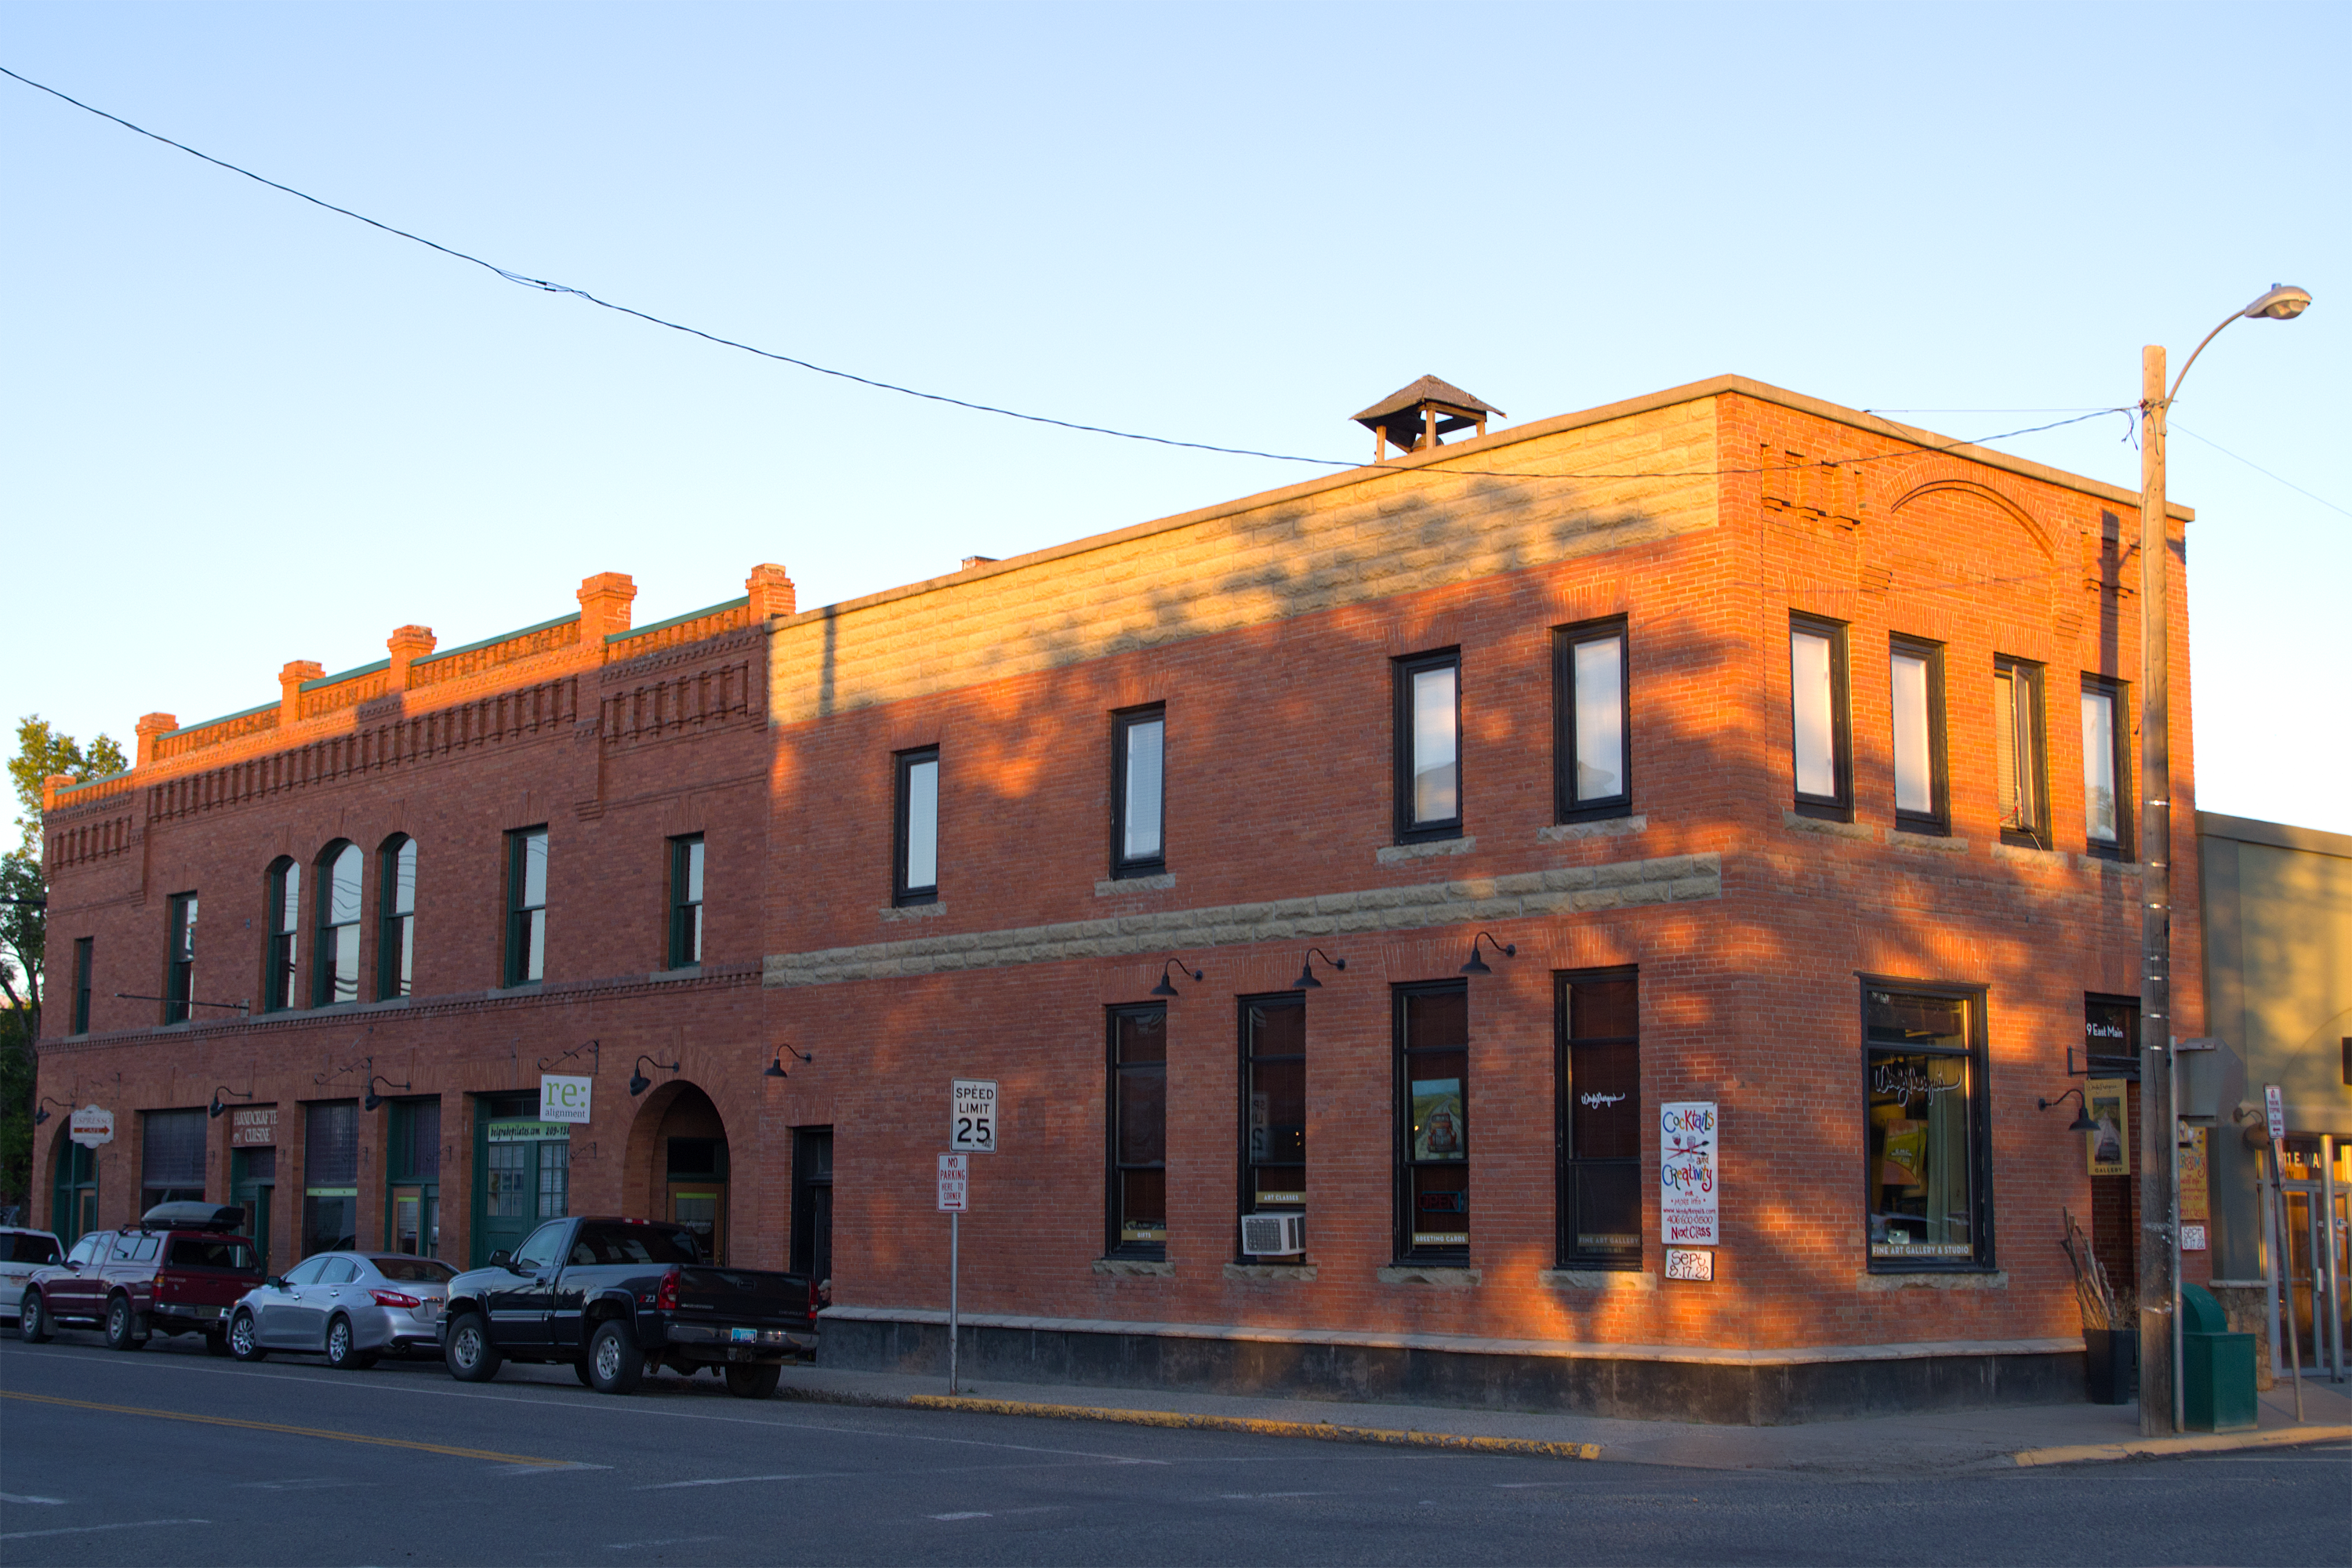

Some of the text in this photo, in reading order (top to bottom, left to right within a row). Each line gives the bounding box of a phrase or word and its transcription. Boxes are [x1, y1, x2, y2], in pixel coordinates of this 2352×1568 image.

[2086, 1023, 2123, 1038] 9 East Main
[546, 1082, 586, 1107] re:
[956, 1087, 993, 1100] SPEED
[545, 1108, 586, 1119] alignment
[959, 1102, 990, 1114] LIMIT
[74, 1116, 112, 1125] ESPRESSO
[234, 1110, 278, 1126] HANDCRAFTE
[245, 1127, 271, 1142] CUISINE
[957, 1117, 990, 1143] 25
[948, 1157, 958, 1168] NO
[1696, 1154, 1709, 1165] and
[941, 1170, 965, 1181] PARKING
[942, 1182, 964, 1191] HERE TO
[1418, 1194, 1459, 1209] OPEN
[1671, 1225, 1711, 1240] Next Class
[1872, 1246, 1888, 1254] FINE
[1890, 1246, 1904, 1254] ART
[1906, 1246, 1936, 1254] GALLERY
[1671, 1250, 1706, 1267] Sept
